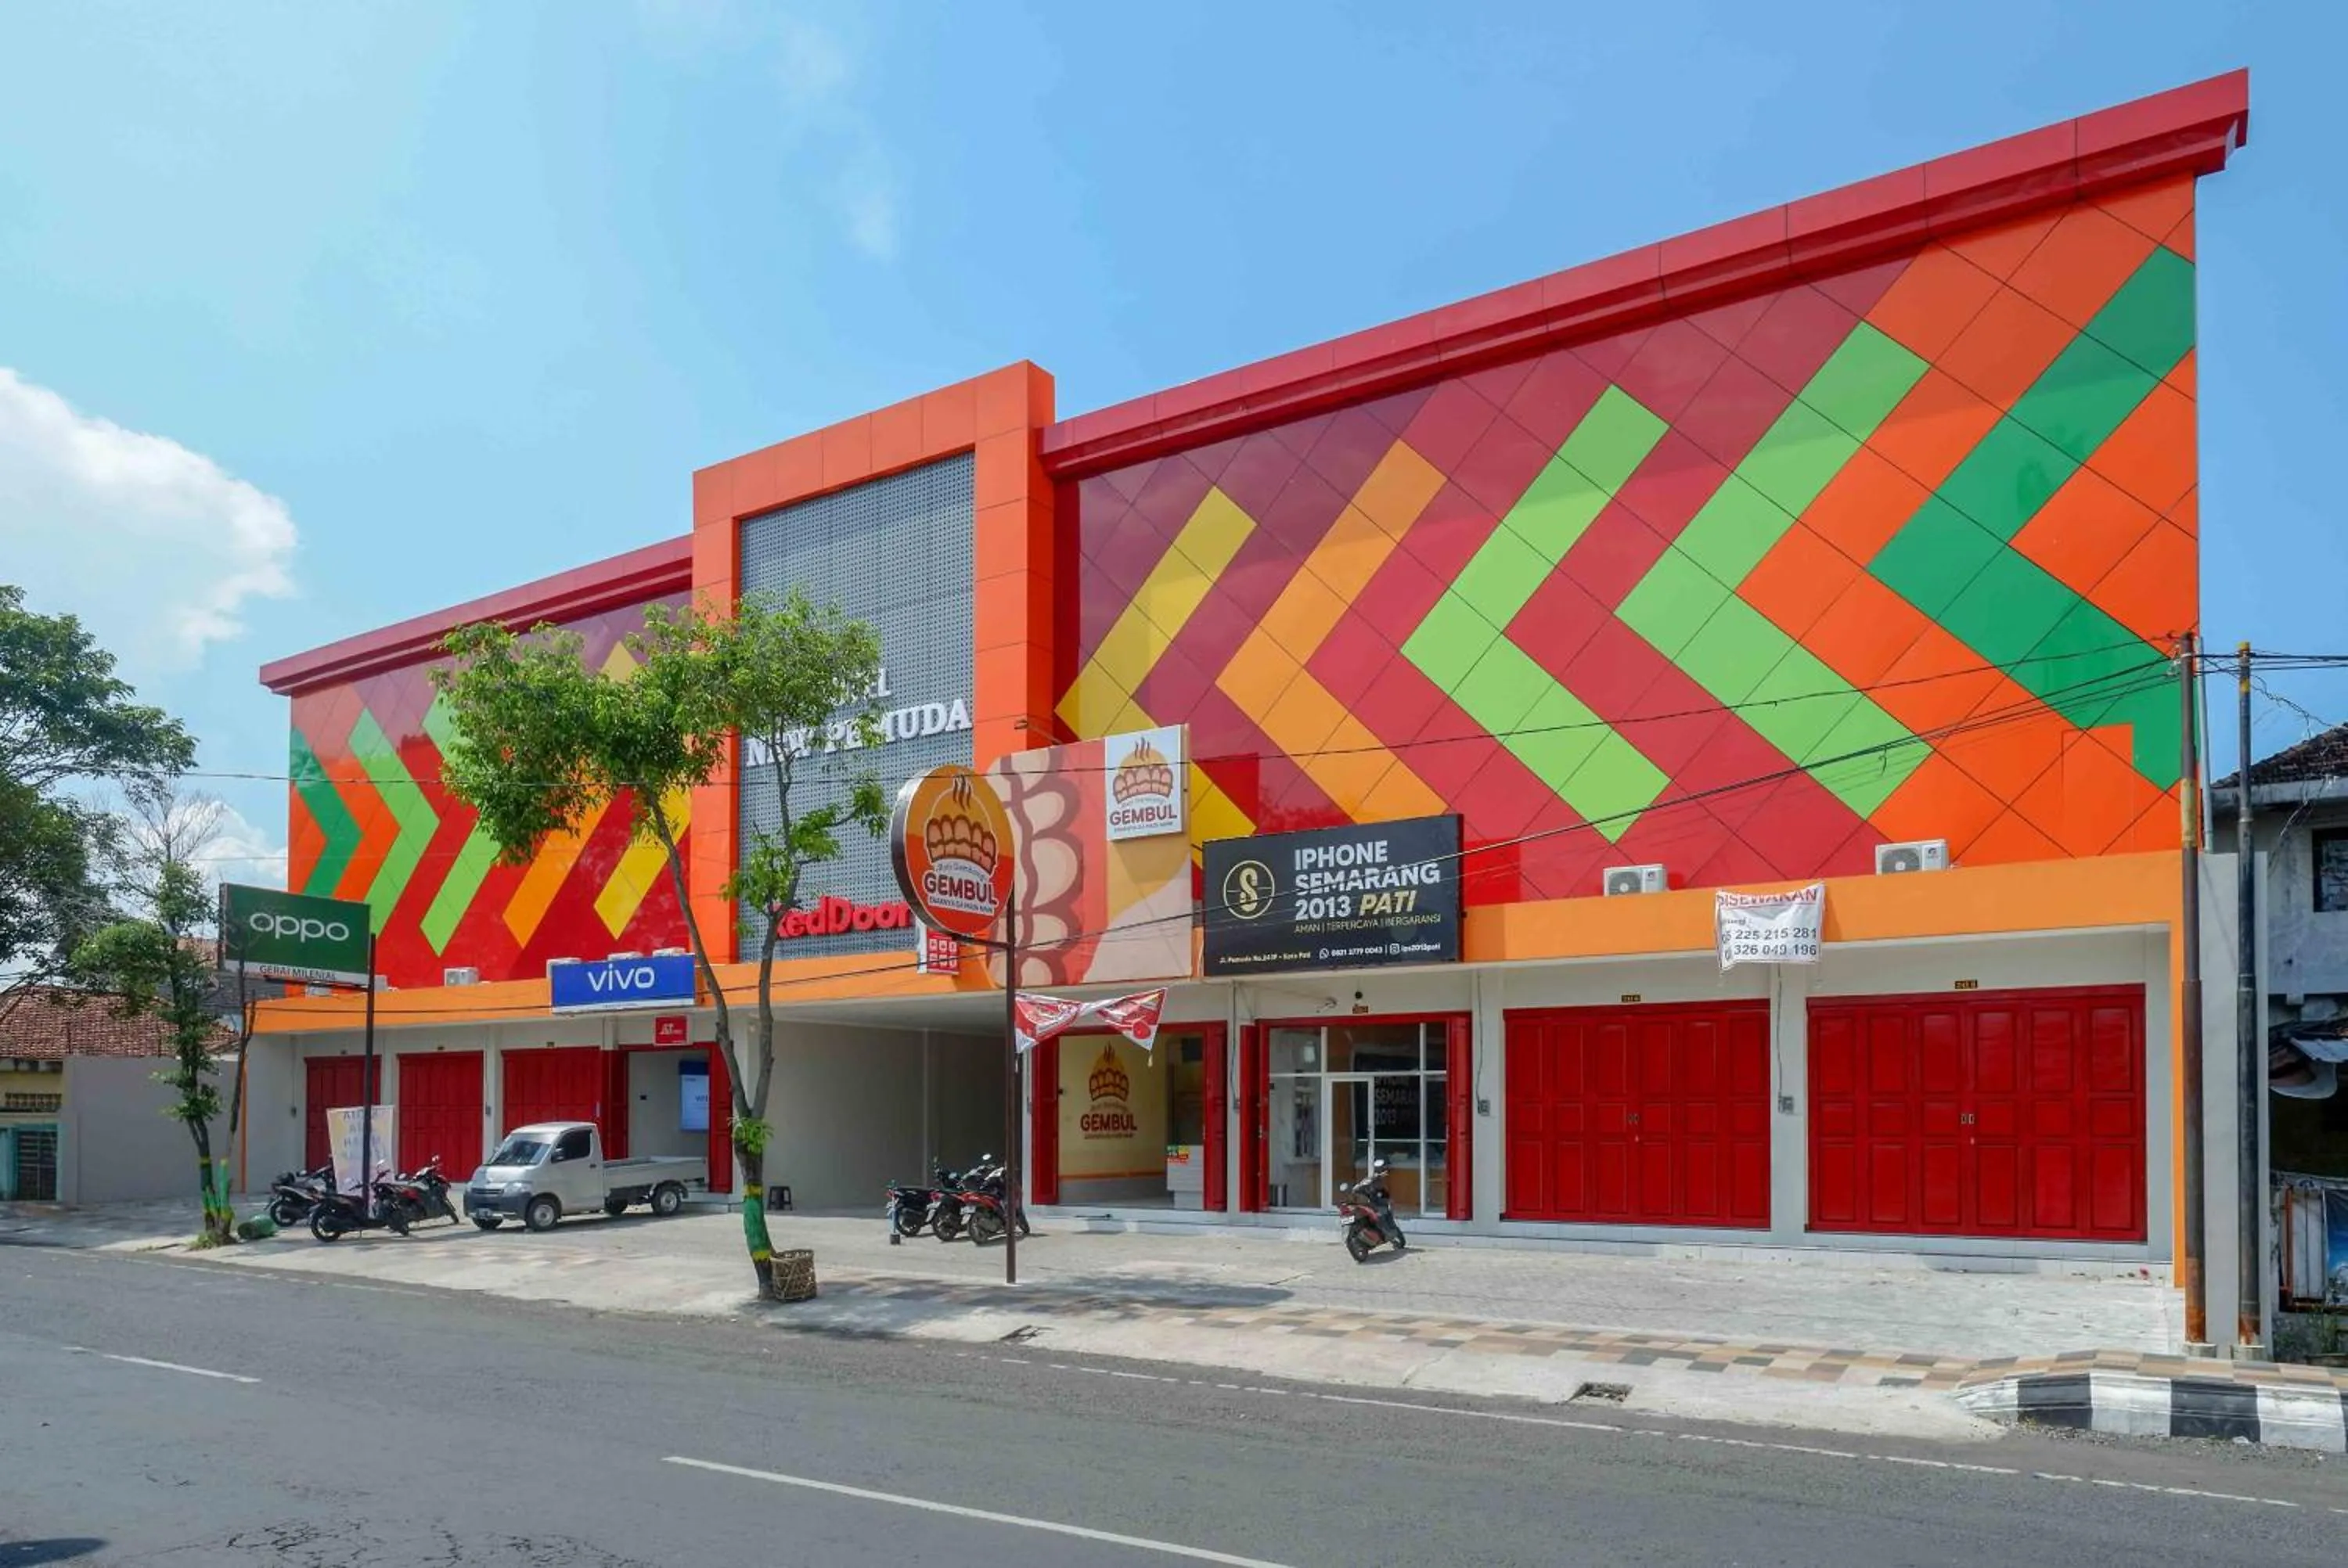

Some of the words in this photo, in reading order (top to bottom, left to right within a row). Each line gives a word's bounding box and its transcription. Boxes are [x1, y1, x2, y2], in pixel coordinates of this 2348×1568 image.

[1110, 804, 1177, 825] GEMBUL
[1295, 840, 1388, 870] IPHONE
[925, 872, 996, 904] GEMBUL
[1295, 862, 1441, 895] SEMARANG
[773, 896, 911, 939] edDoor
[1295, 895, 1352, 920] 2013
[1359, 890, 1417, 916] PATI
[250, 913, 349, 943] oppo
[1294, 922, 1320, 933] AMAN
[1735, 930, 1759, 940] 225
[1763, 928, 1788, 940] 215
[1793, 927, 1817, 938] 281
[1734, 944, 1759, 955] 326
[1794, 944, 1817, 955] 196
[589, 963, 654, 991] vivo
[1081, 1113, 1137, 1131] GEMBUL
